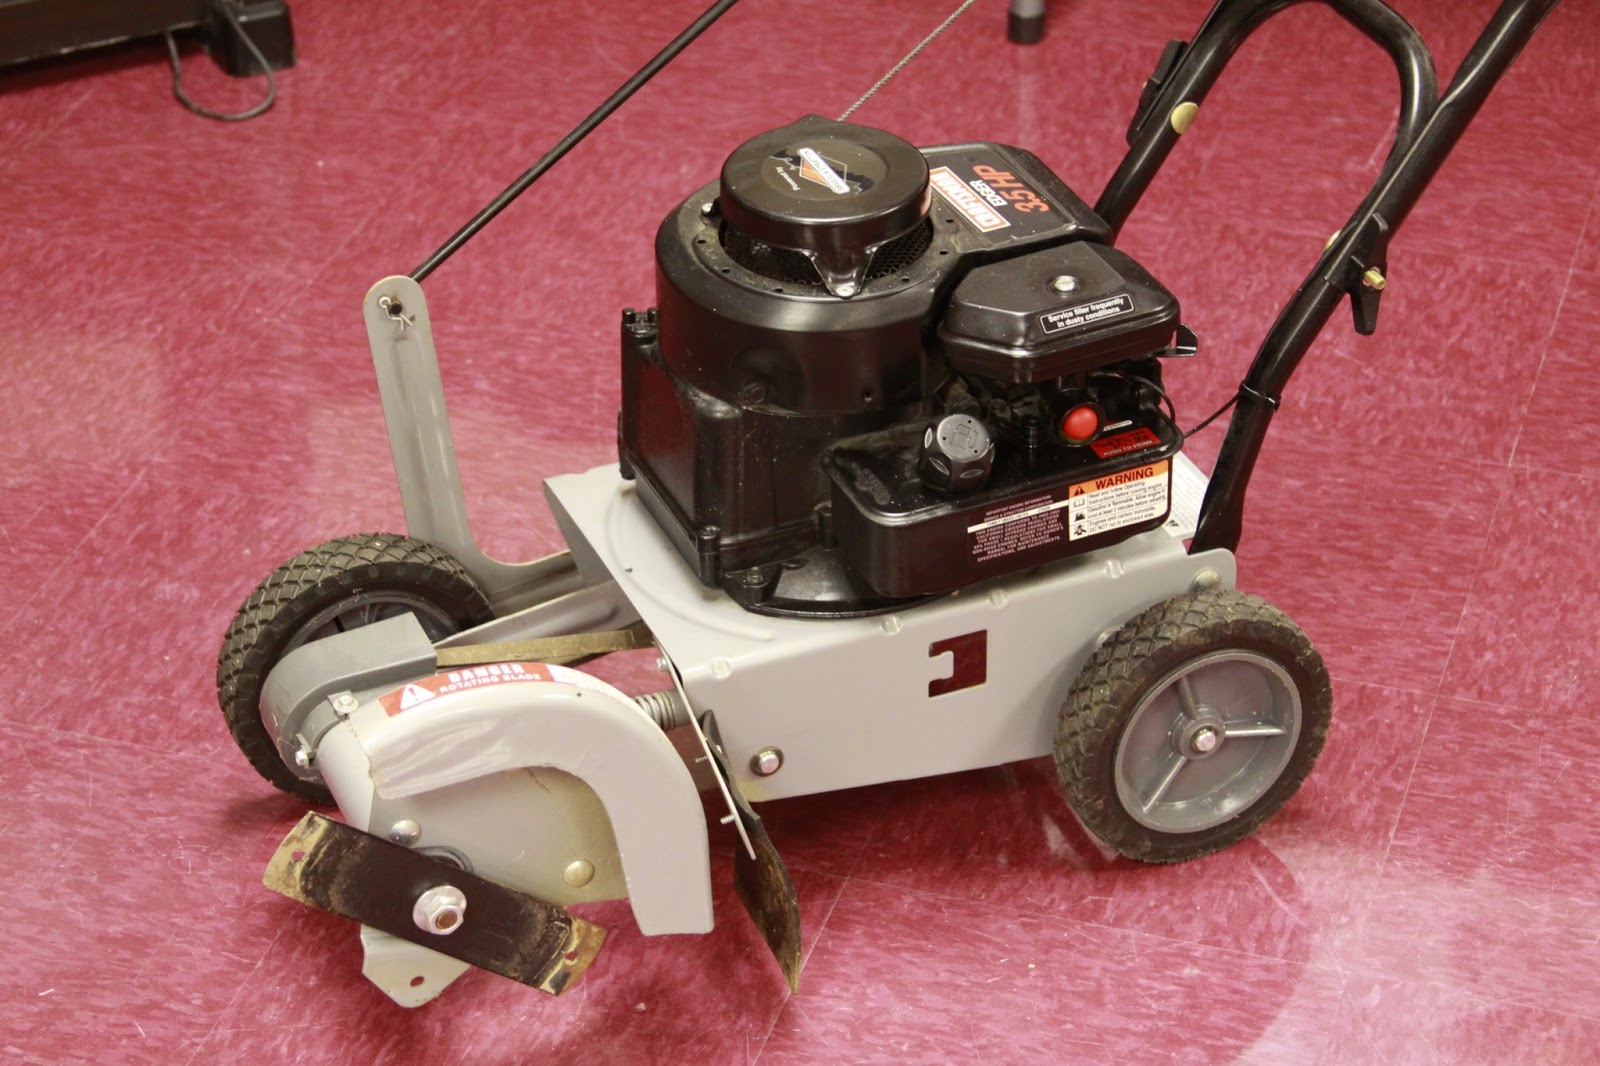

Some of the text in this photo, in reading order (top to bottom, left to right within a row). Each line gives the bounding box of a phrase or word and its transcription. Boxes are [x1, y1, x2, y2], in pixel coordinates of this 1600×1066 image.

[780, 172, 800, 191] Powered
[930, 171, 1000, 226] CRAFTSMAN
[969, 180, 1008, 206] EDGER
[1048, 298, 1124, 322] Service filter frequently
[1065, 315, 1084, 325] dusty
[1085, 306, 1120, 320] conditions
[1133, 440, 1153, 448] PRIME
[1096, 467, 1154, 490] WARNING
[1124, 481, 1145, 490] Operating
[1088, 504, 1107, 512] Gasoline
[1148, 490, 1162, 500] engine
[1089, 496, 1114, 505] Instructions
[1115, 491, 1129, 499] before
[1130, 487, 1147, 497] running
[1089, 517, 1106, 526] Engines
[1118, 510, 1132, 518] carbon
[448, 664, 525, 683] DANGER
[439, 676, 500, 693] ROTATING
